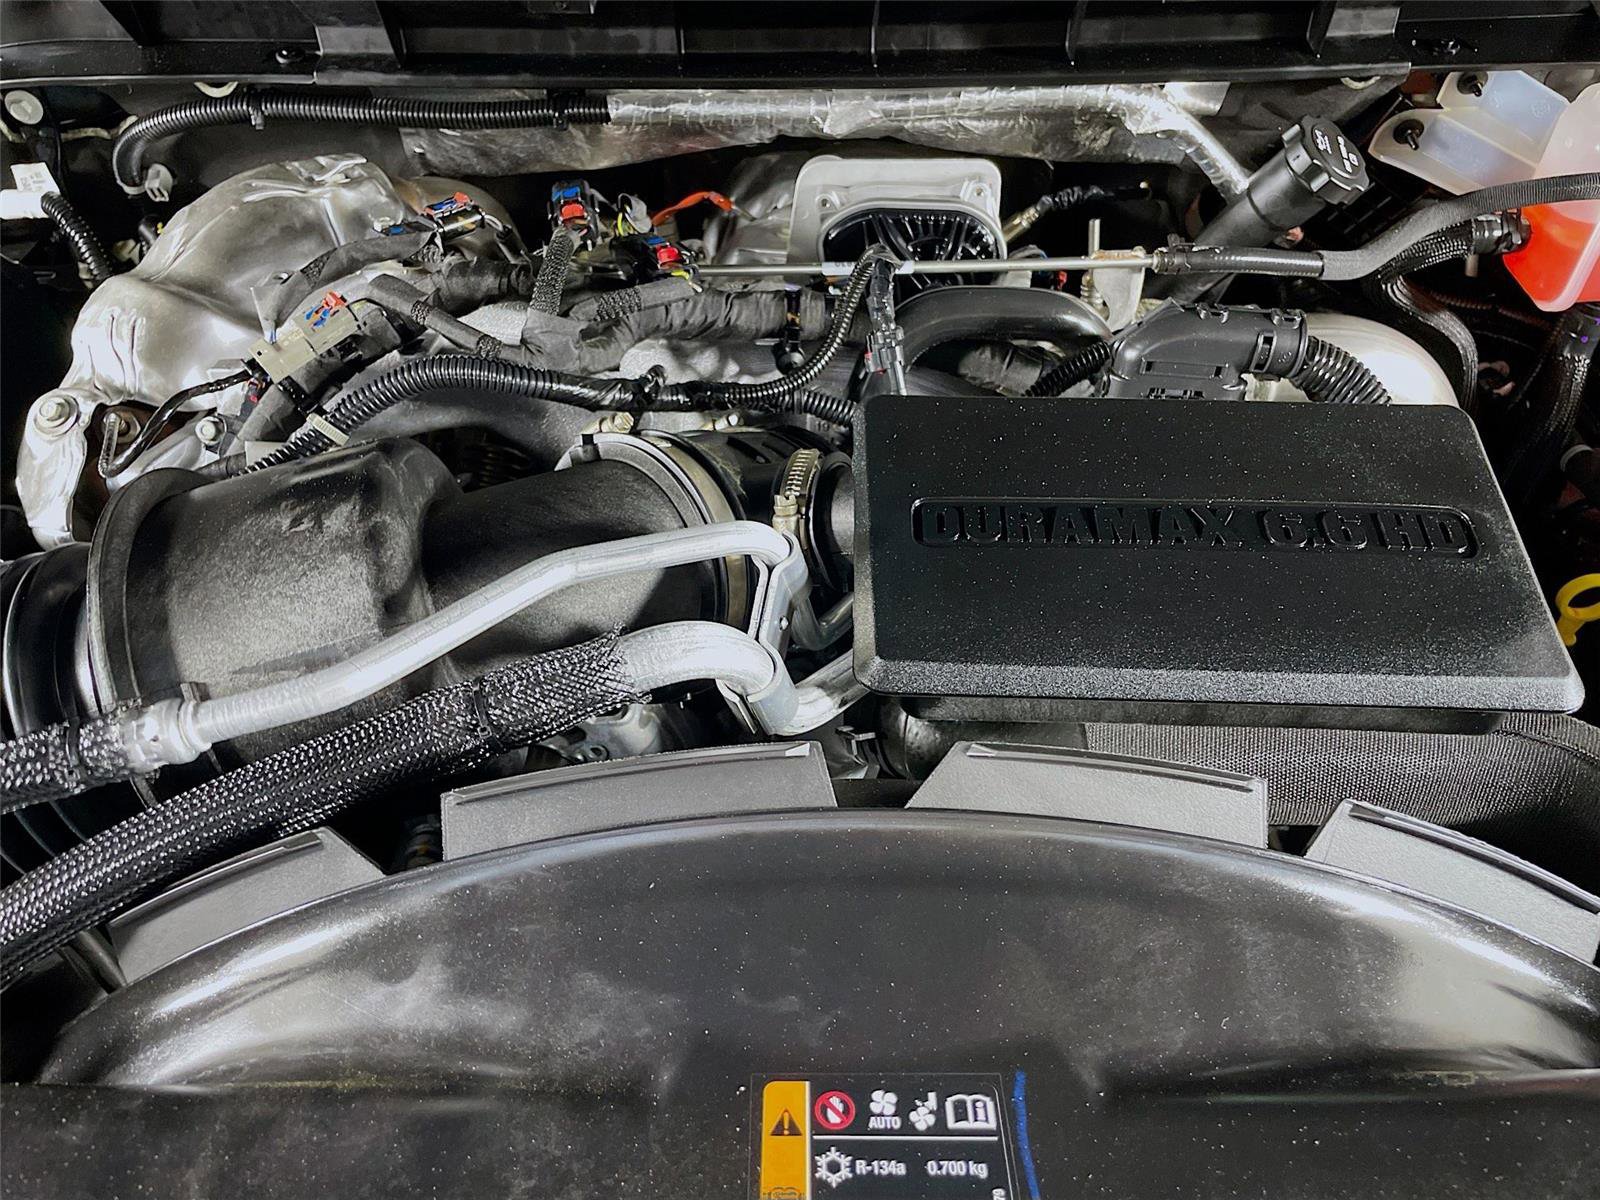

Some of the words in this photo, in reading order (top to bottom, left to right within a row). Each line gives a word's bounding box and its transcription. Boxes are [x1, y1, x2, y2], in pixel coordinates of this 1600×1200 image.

[920, 503, 1244, 547] DURAMAX
[1263, 508, 1368, 549] 6.6
[1376, 512, 1471, 554] HD
[869, 1116, 901, 1129] AUTO
[855, 1160, 907, 1176] R-134a
[927, 1160, 967, 1176] 0.700
[969, 1161, 988, 1179] kg
